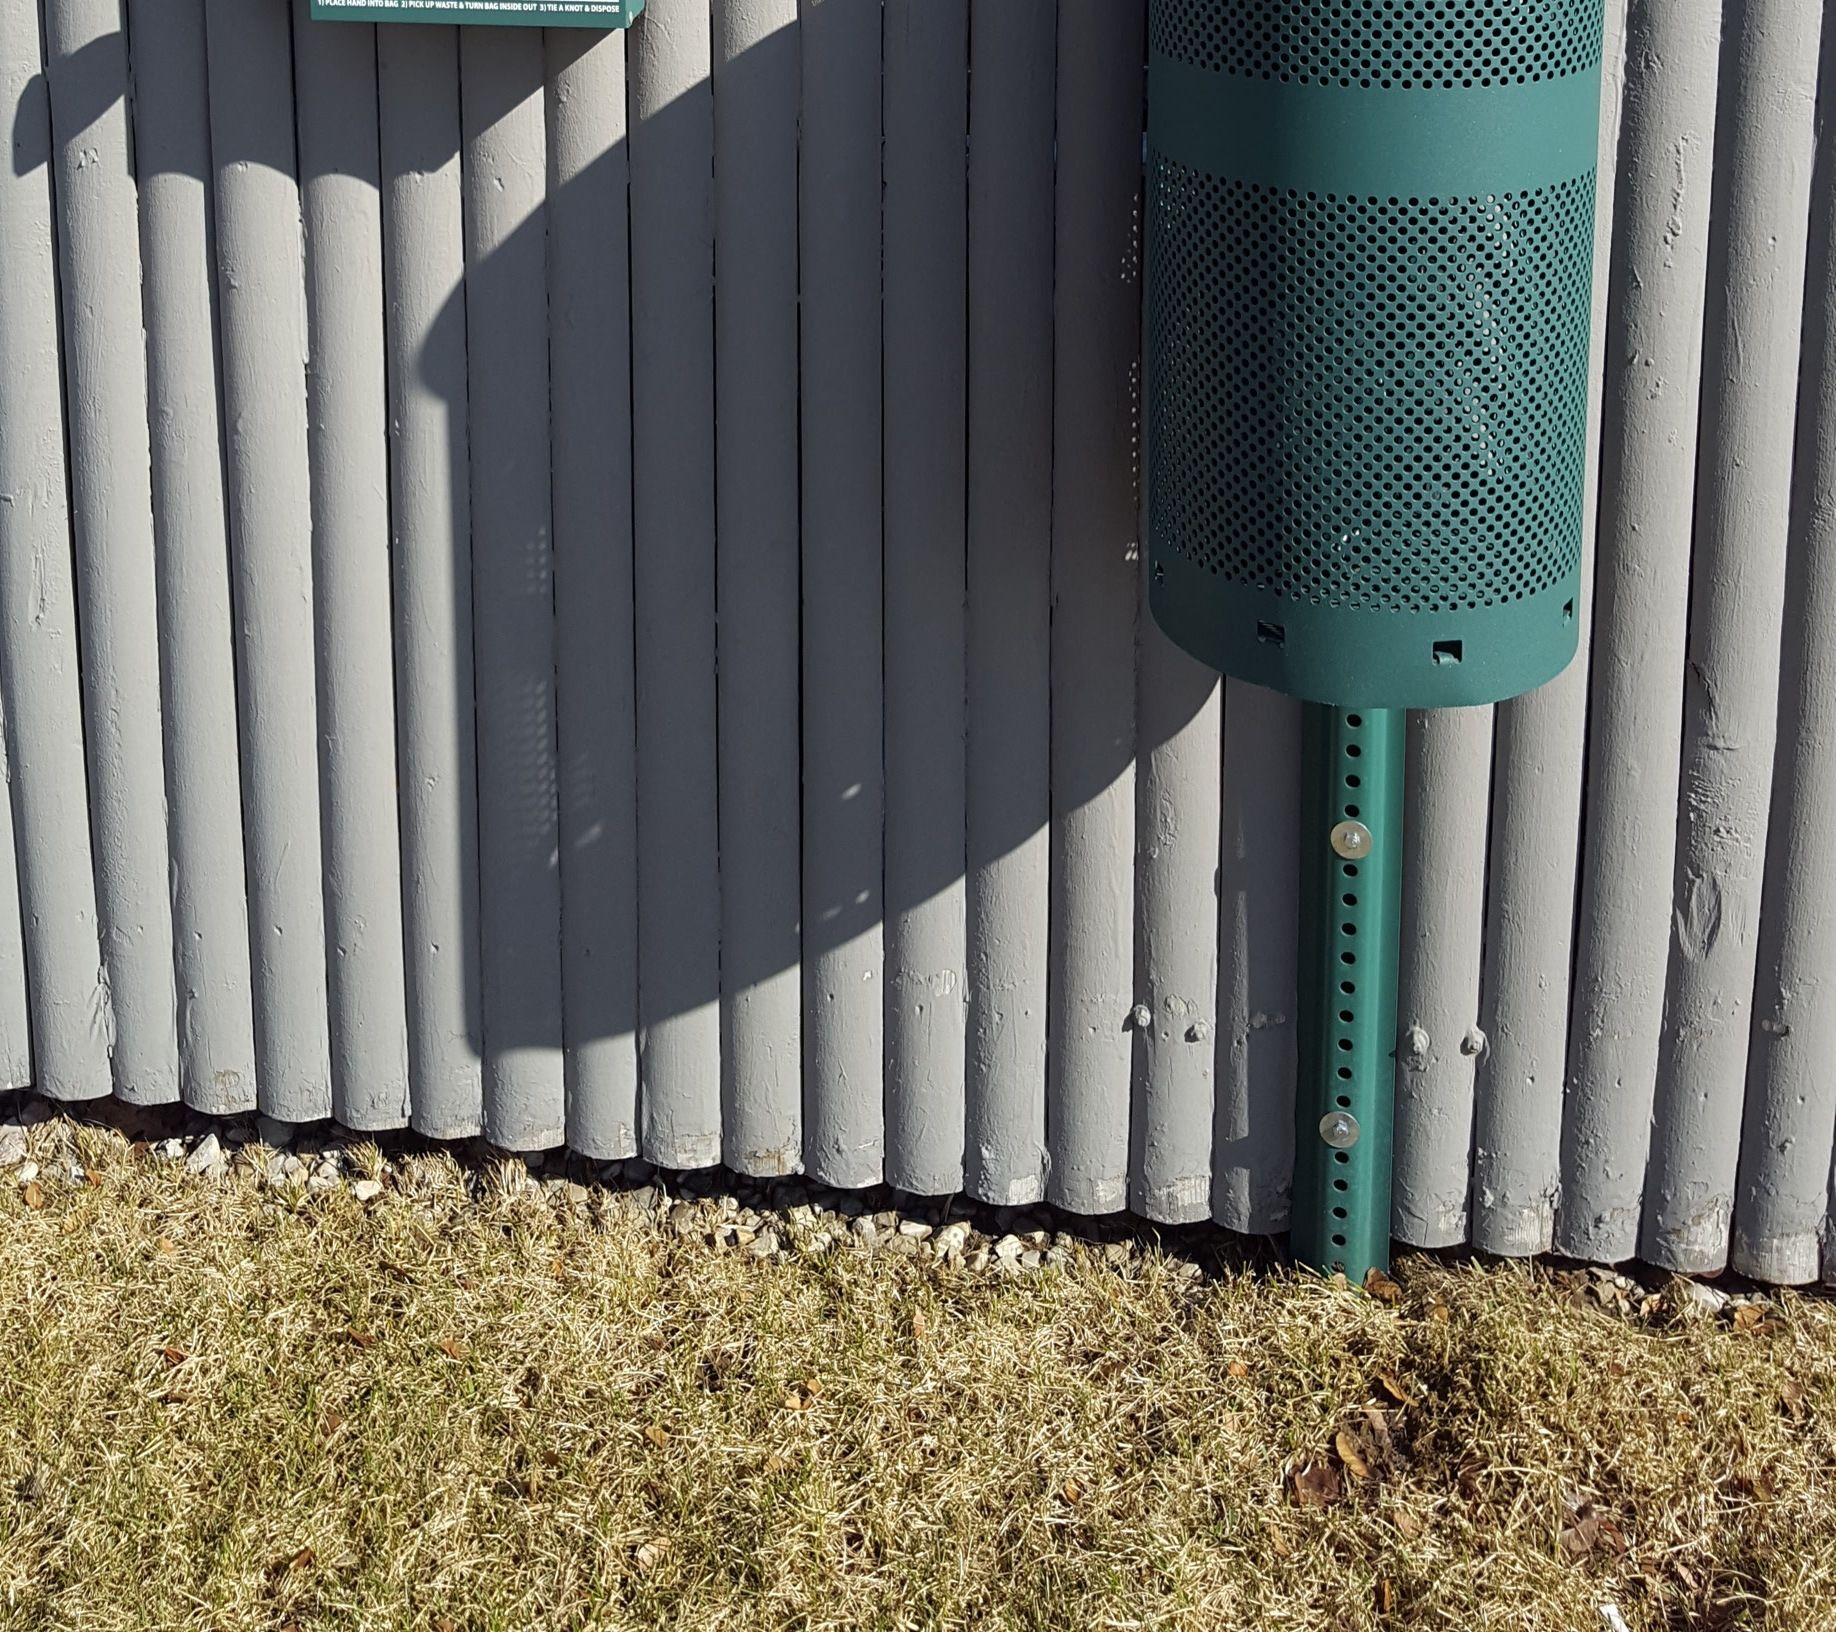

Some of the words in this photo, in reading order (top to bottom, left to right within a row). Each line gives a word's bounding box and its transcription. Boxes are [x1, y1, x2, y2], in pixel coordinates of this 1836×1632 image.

[347, 0, 366, 7] HAND
[367, 0, 383, 7] INTO
[384, 0, 399, 7] BAG
[401, 0, 408, 8] 2)
[408, 0, 424, 8] PICK
[425, 0, 434, 8] UP
[435, 1, 458, 9] WASTE
[459, 1, 464, 9] &
[465, 2, 484, 10] TURN
[485, 2, 498, 10] BAG
[500, 2, 522, 11] INSIDE
[522, 3, 537, 11] OUT
[539, 3, 547, 12] 3)
[547, 3, 558, 11] TIE
[565, 4, 584, 12] KNOT
[584, 4, 590, 12] &
[591, 4, 620, 13] DISPOSE
